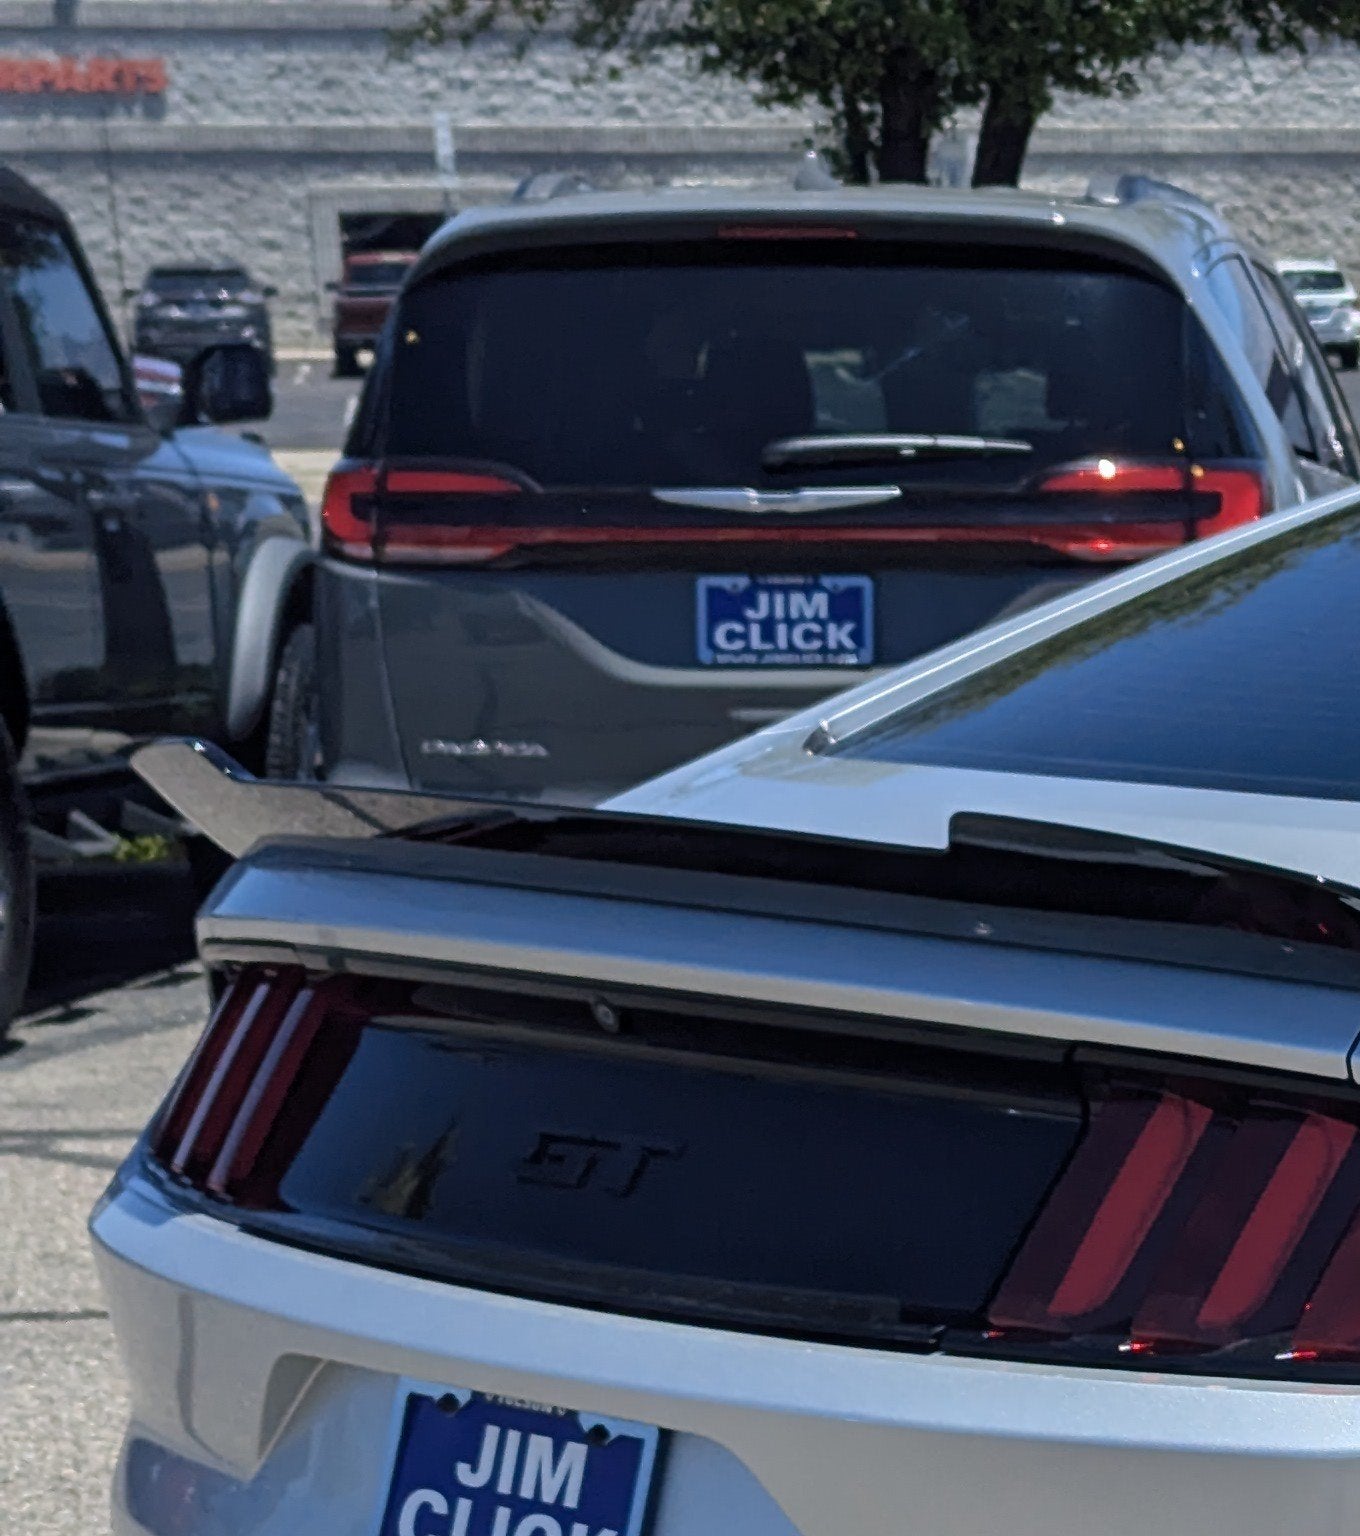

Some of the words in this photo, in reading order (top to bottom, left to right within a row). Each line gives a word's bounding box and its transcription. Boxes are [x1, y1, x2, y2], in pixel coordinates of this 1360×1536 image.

[744, 591, 830, 621] JIM
[713, 621, 858, 651] CLICK
[516, 1132, 690, 1199] GT
[455, 1423, 589, 1510] JIM
